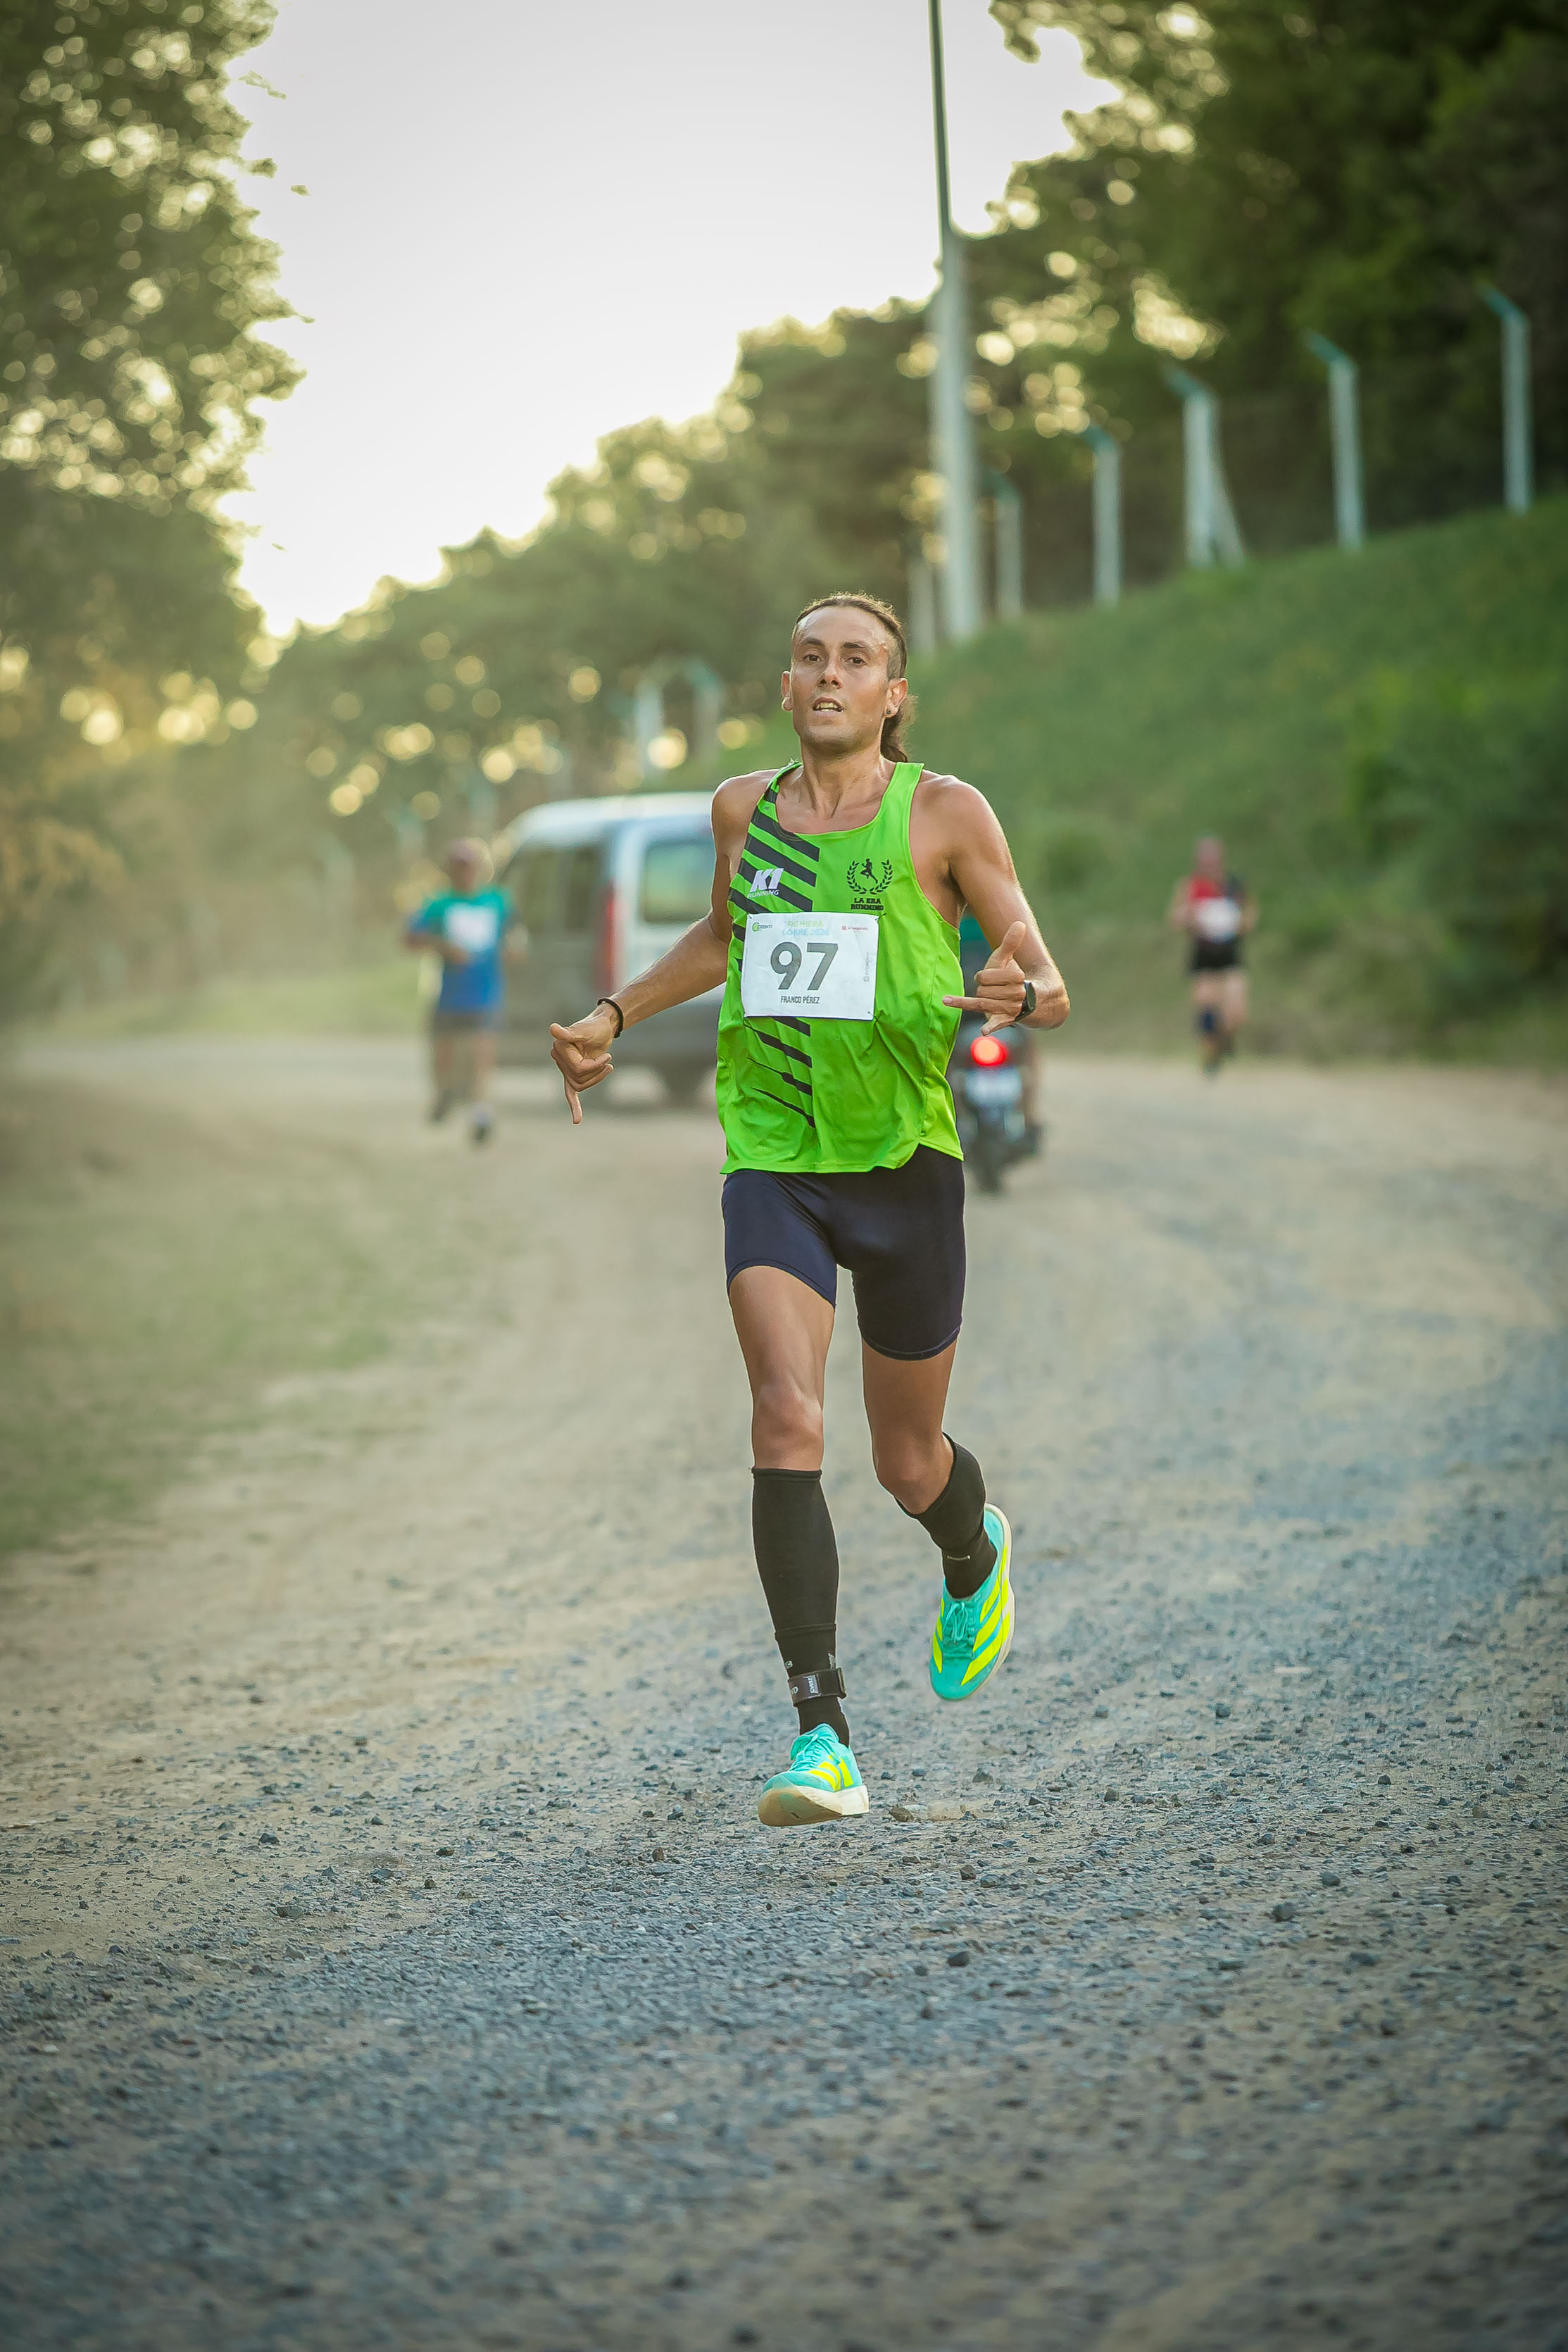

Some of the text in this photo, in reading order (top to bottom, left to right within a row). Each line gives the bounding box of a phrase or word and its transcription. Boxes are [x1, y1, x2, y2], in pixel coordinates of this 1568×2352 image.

[749, 868, 784, 892] K1
[770, 941, 839, 991] 97
[803, 994, 820, 1004] PÉREZ
